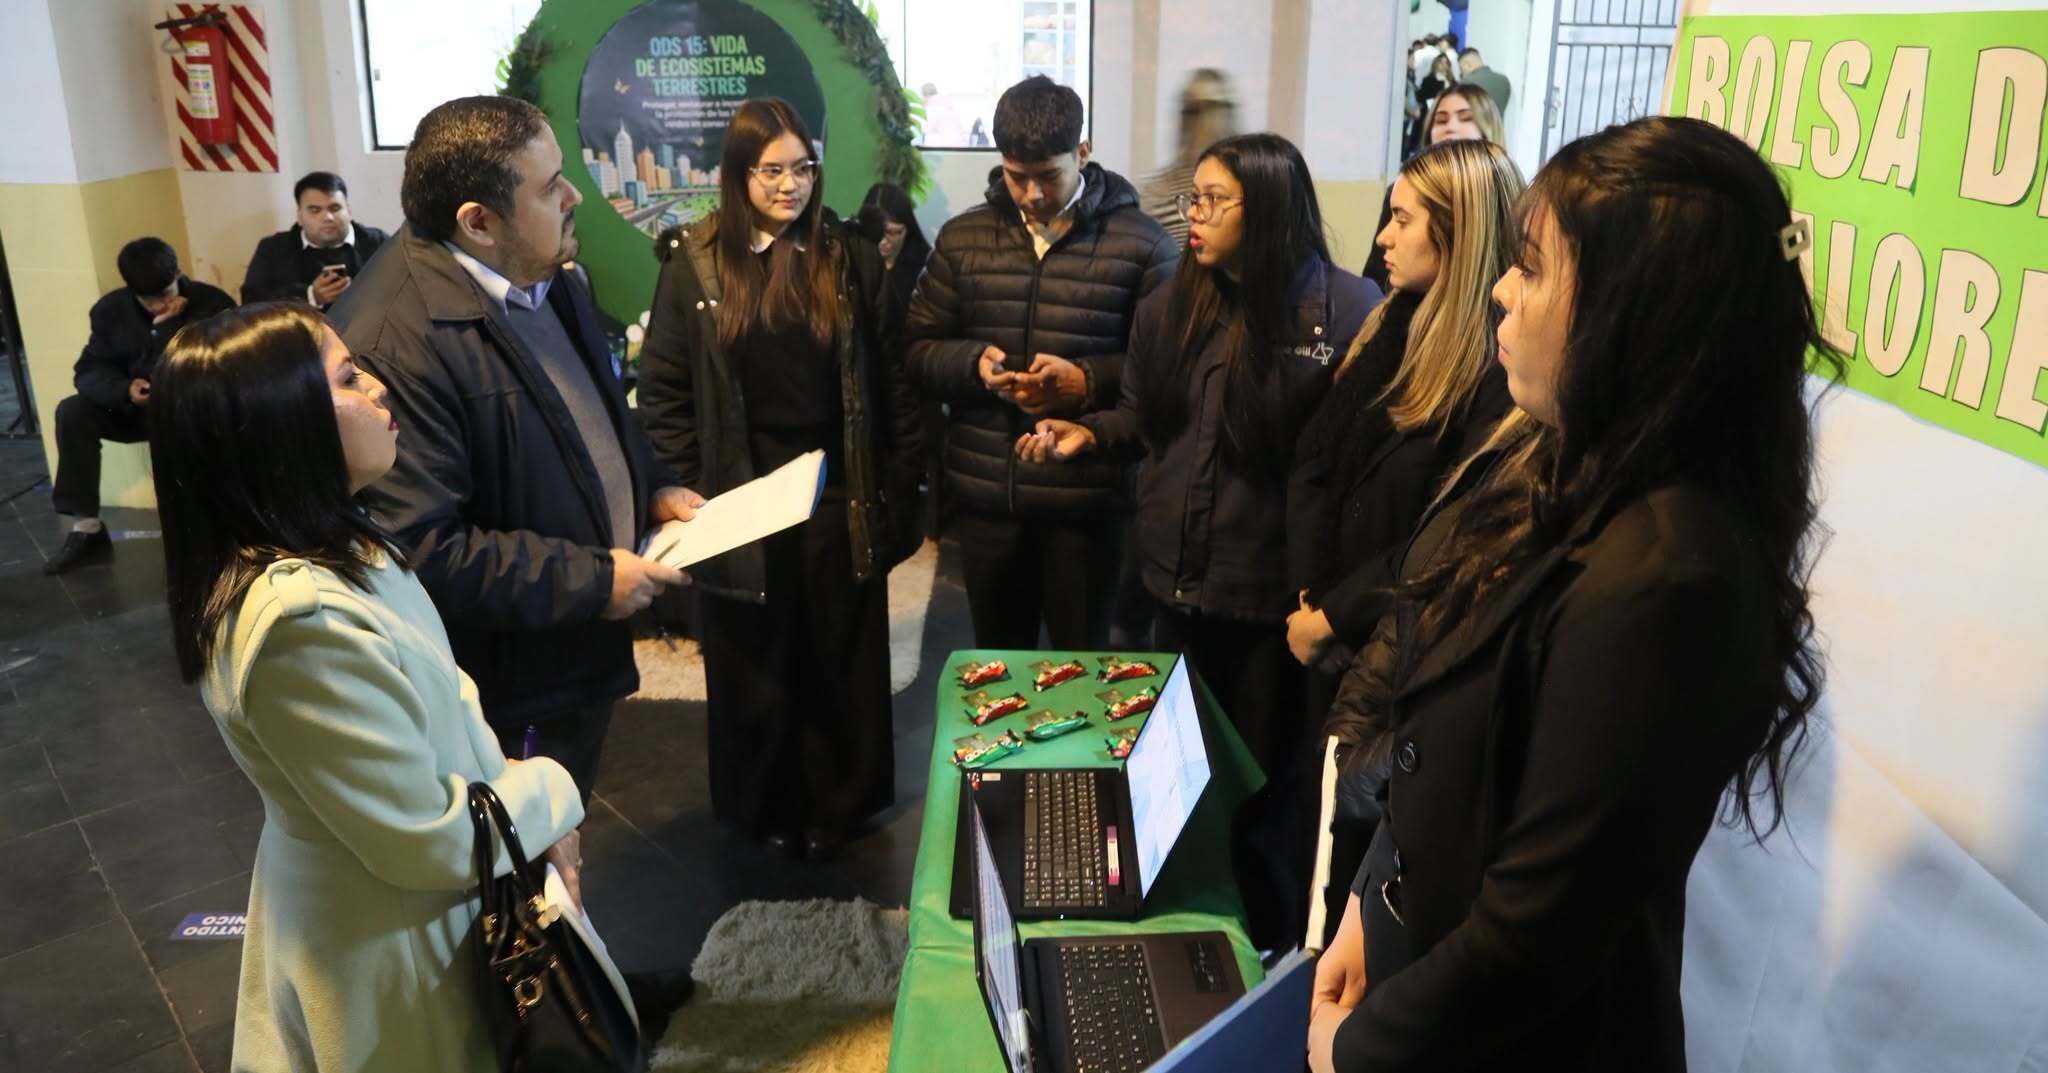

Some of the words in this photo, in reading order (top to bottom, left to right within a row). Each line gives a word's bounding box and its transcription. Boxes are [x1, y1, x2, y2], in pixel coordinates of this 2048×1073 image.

[650, 36, 682, 56] ODS
[685, 35, 708, 55] 15:
[709, 34, 748, 55] VIDA
[635, 58, 657, 77] DE
[660, 56, 766, 77] ECOSISTEMAS
[652, 76, 748, 96] TERRESTRES
[1686, 35, 1930, 192] BOLSA
[1959, 46, 2048, 218] D
[183, 926, 247, 936] NTIDO
